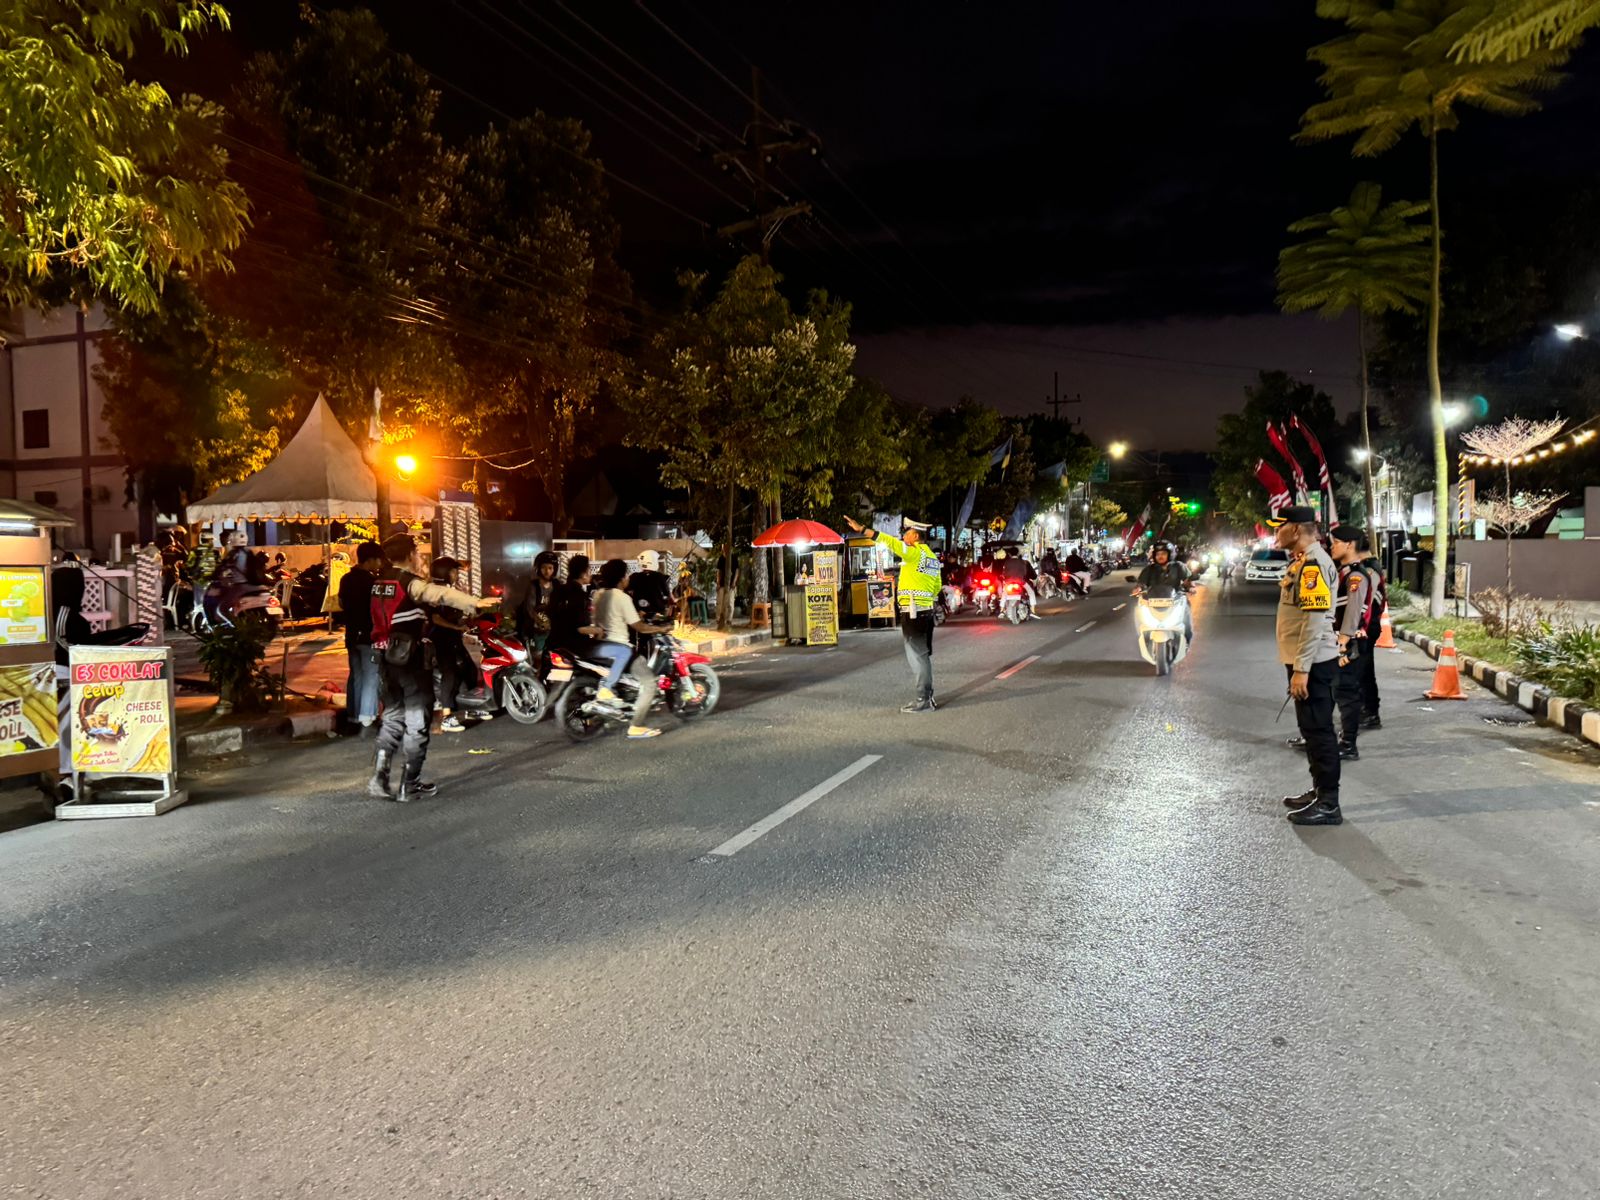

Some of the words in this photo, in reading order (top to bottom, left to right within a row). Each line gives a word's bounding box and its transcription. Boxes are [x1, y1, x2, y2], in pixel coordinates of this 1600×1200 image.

[807, 595, 833, 603] KOTA
[76, 664, 96, 682] ES
[98, 661, 164, 681] COKLAT
[83, 684, 125, 700] Celup
[126, 701, 162, 712] CHEESE
[140, 713, 165, 724] ROLL
